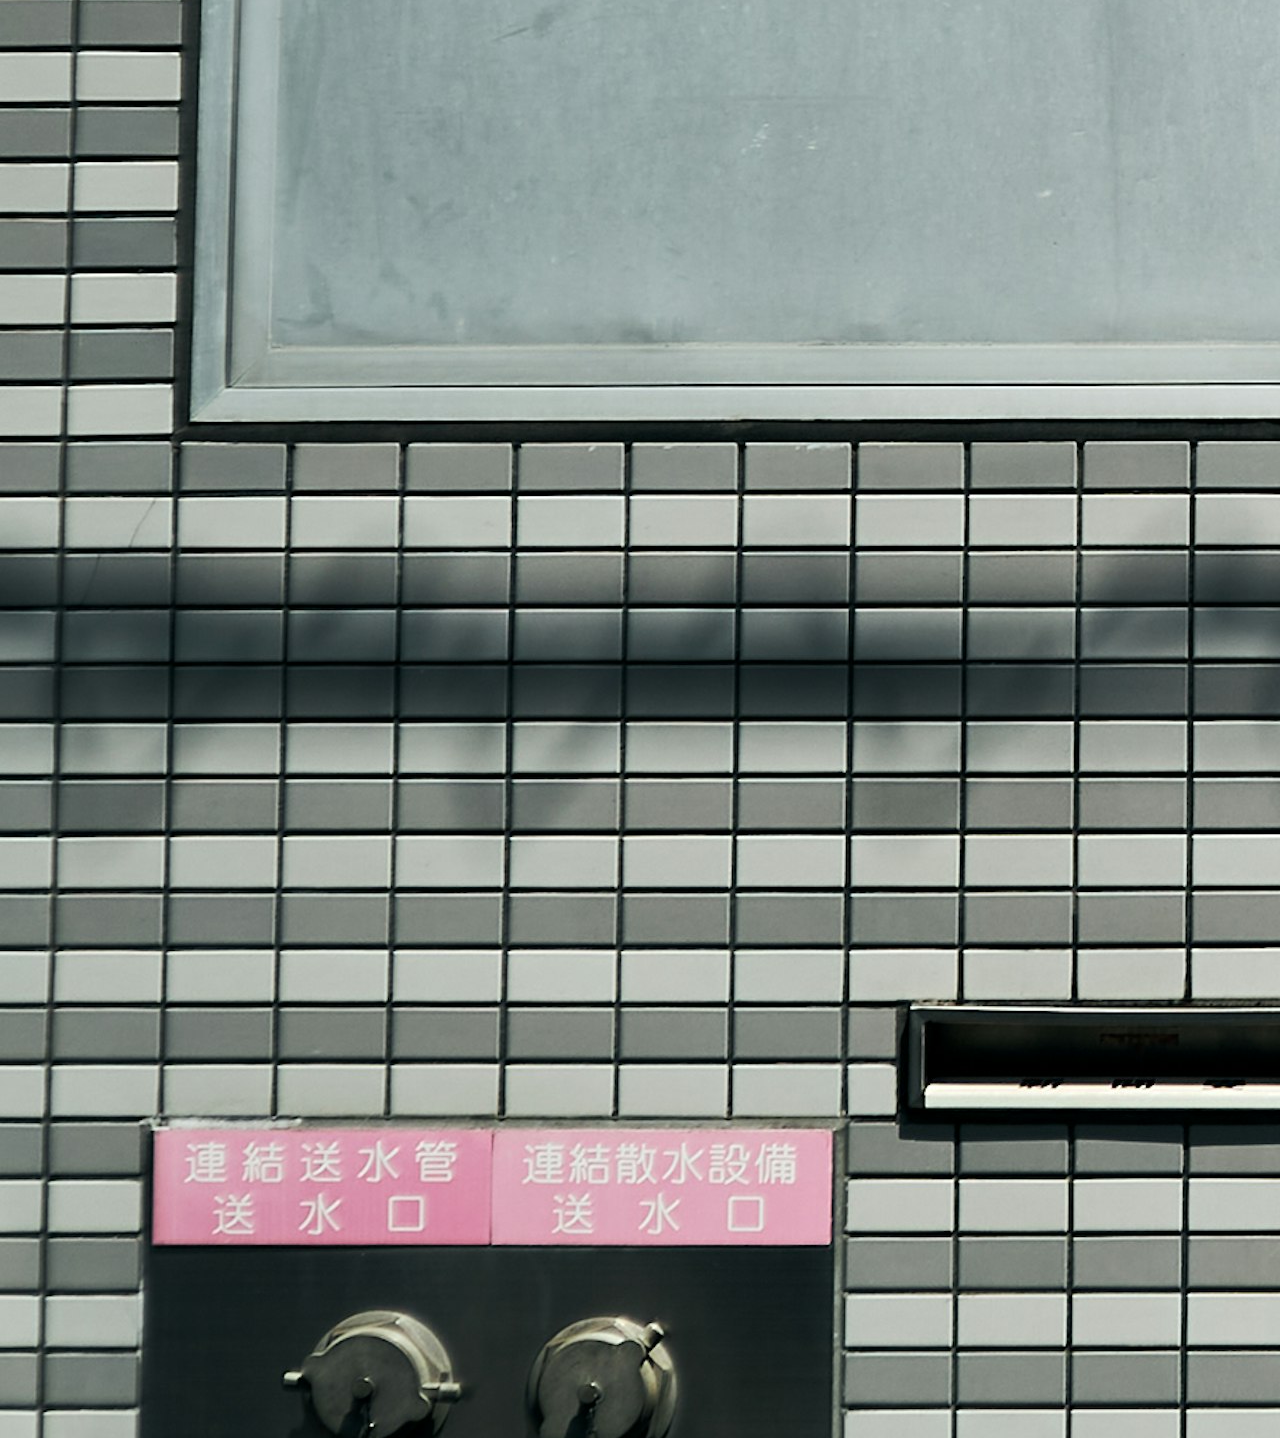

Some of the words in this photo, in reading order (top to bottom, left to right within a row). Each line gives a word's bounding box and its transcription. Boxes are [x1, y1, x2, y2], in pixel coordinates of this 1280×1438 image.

[184, 1140, 458, 1184] 連結送水管
[522, 1142, 798, 1186] 連結散水設備
[212, 1192, 426, 1236] 送水口
[551, 1192, 765, 1236] 送水口
